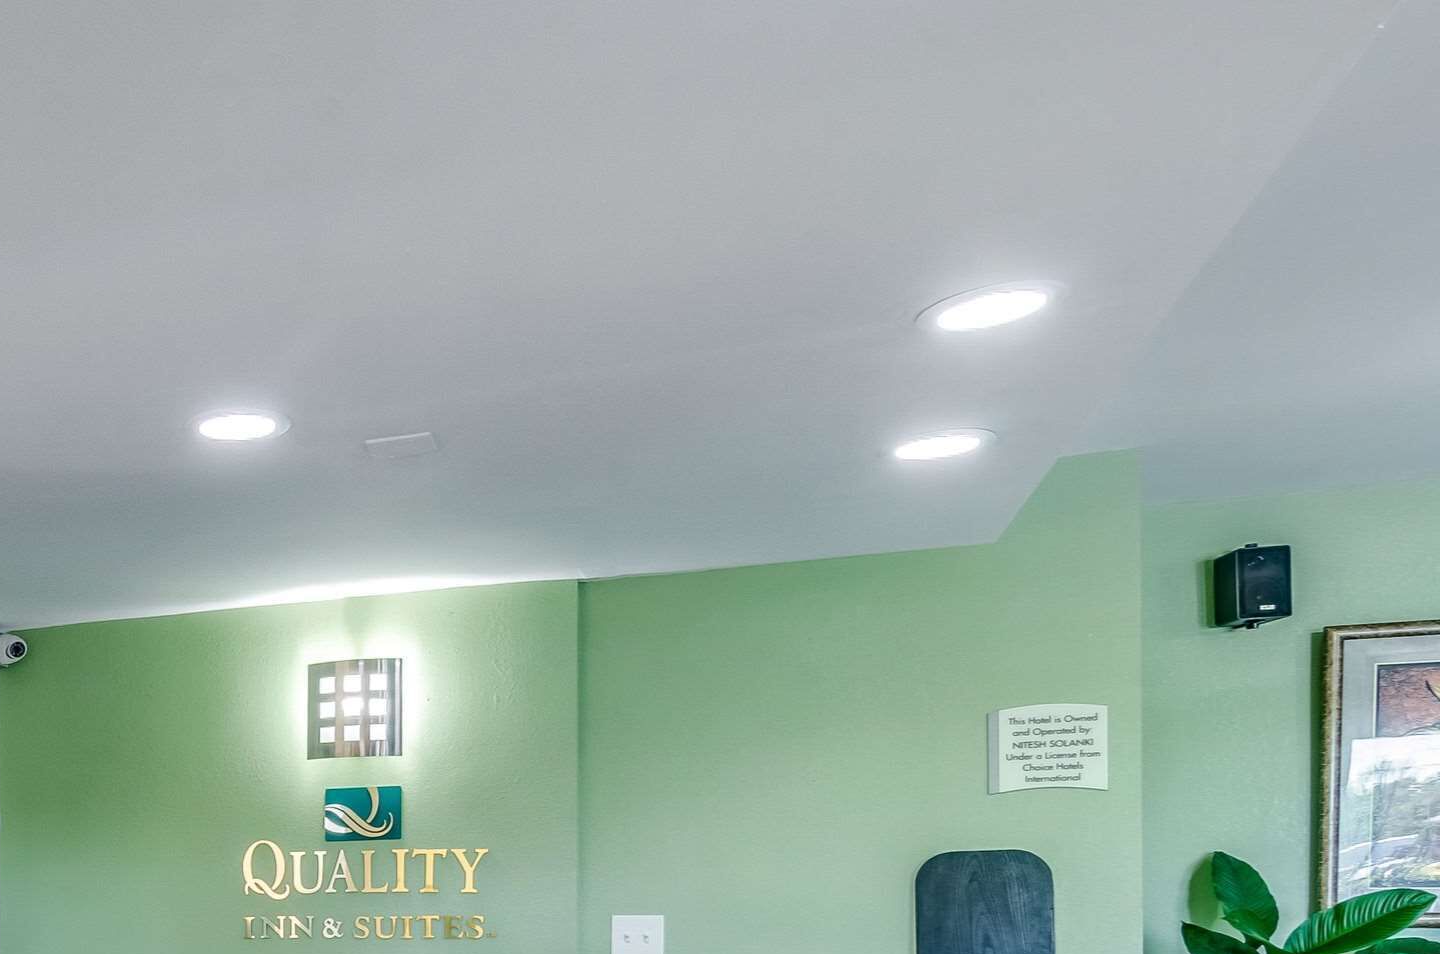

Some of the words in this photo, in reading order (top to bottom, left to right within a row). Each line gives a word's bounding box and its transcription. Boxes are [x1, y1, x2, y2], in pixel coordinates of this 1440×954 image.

[1008, 717, 1026, 725] This
[1028, 716, 1051, 725] Hotel
[1064, 713, 1098, 722] Owned
[1012, 728, 1030, 737] and
[1032, 726, 1076, 737] Operated
[1079, 726, 1092, 736] by
[1012, 740, 1046, 749] NITESH
[1049, 738, 1094, 748] SOLANKI
[1006, 753, 1033, 761] Under
[1045, 751, 1077, 760] License
[1080, 749, 1101, 758] from
[1022, 763, 1054, 771] Choice
[1056, 762, 1084, 770] Hotels
[1025, 773, 1081, 783] International
[242, 839, 489, 900] QUALITY
[243, 914, 315, 940] INN
[321, 917, 344, 939] &
[352, 914, 486, 940] SUITES
